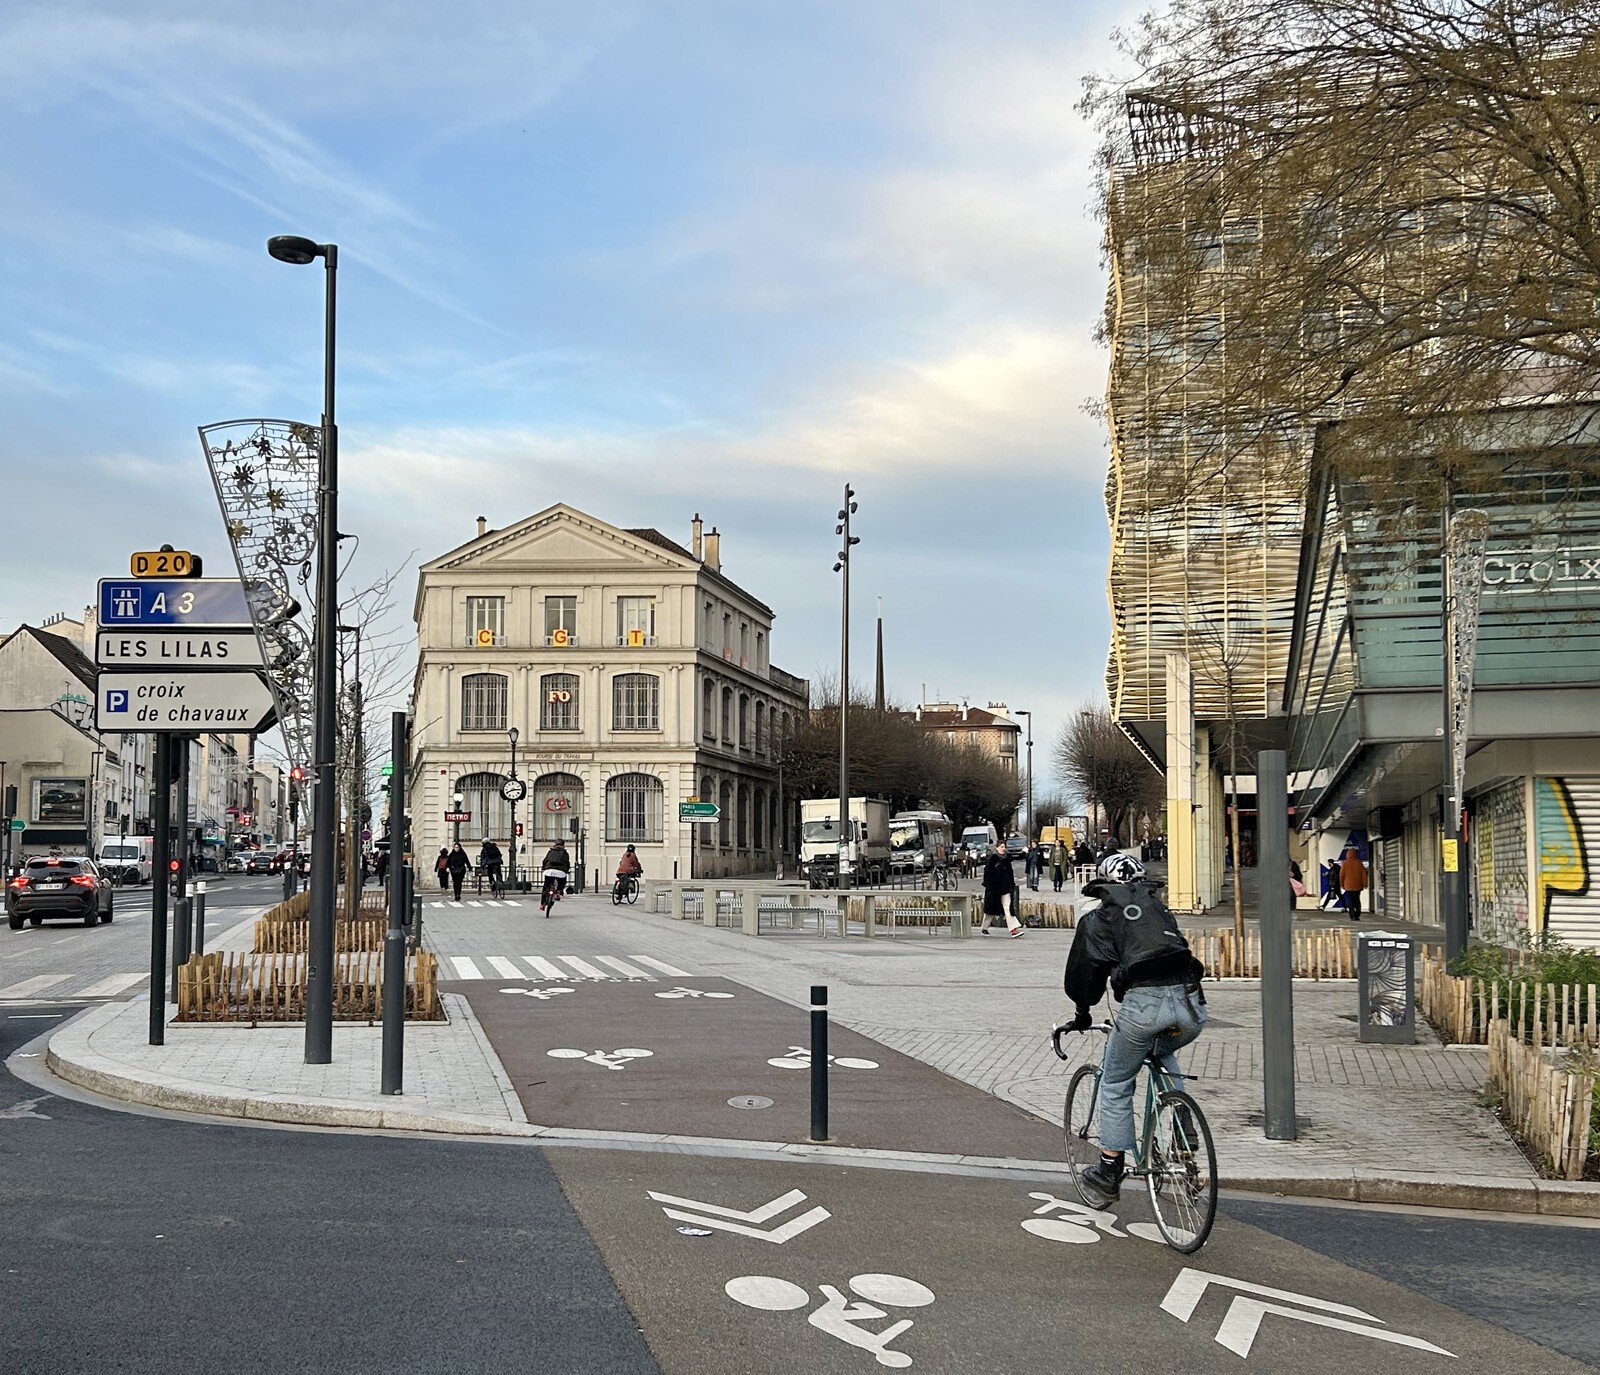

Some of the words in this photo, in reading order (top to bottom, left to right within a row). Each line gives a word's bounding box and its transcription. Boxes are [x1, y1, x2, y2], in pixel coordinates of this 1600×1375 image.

[136, 556, 149, 573] D
[156, 554, 186, 573] 20
[150, 592, 167, 614] A
[177, 592, 196, 614] 3
[479, 630, 491, 643] C
[554, 630, 567, 643] G
[631, 630, 642, 643] T
[105, 640, 147, 657] LES
[161, 640, 229, 658] LILAS
[136, 680, 186, 698] croix
[548, 690, 571, 702] FO
[109, 692, 125, 711] P
[136, 704, 159, 722] de
[167, 704, 249, 722] chavaux
